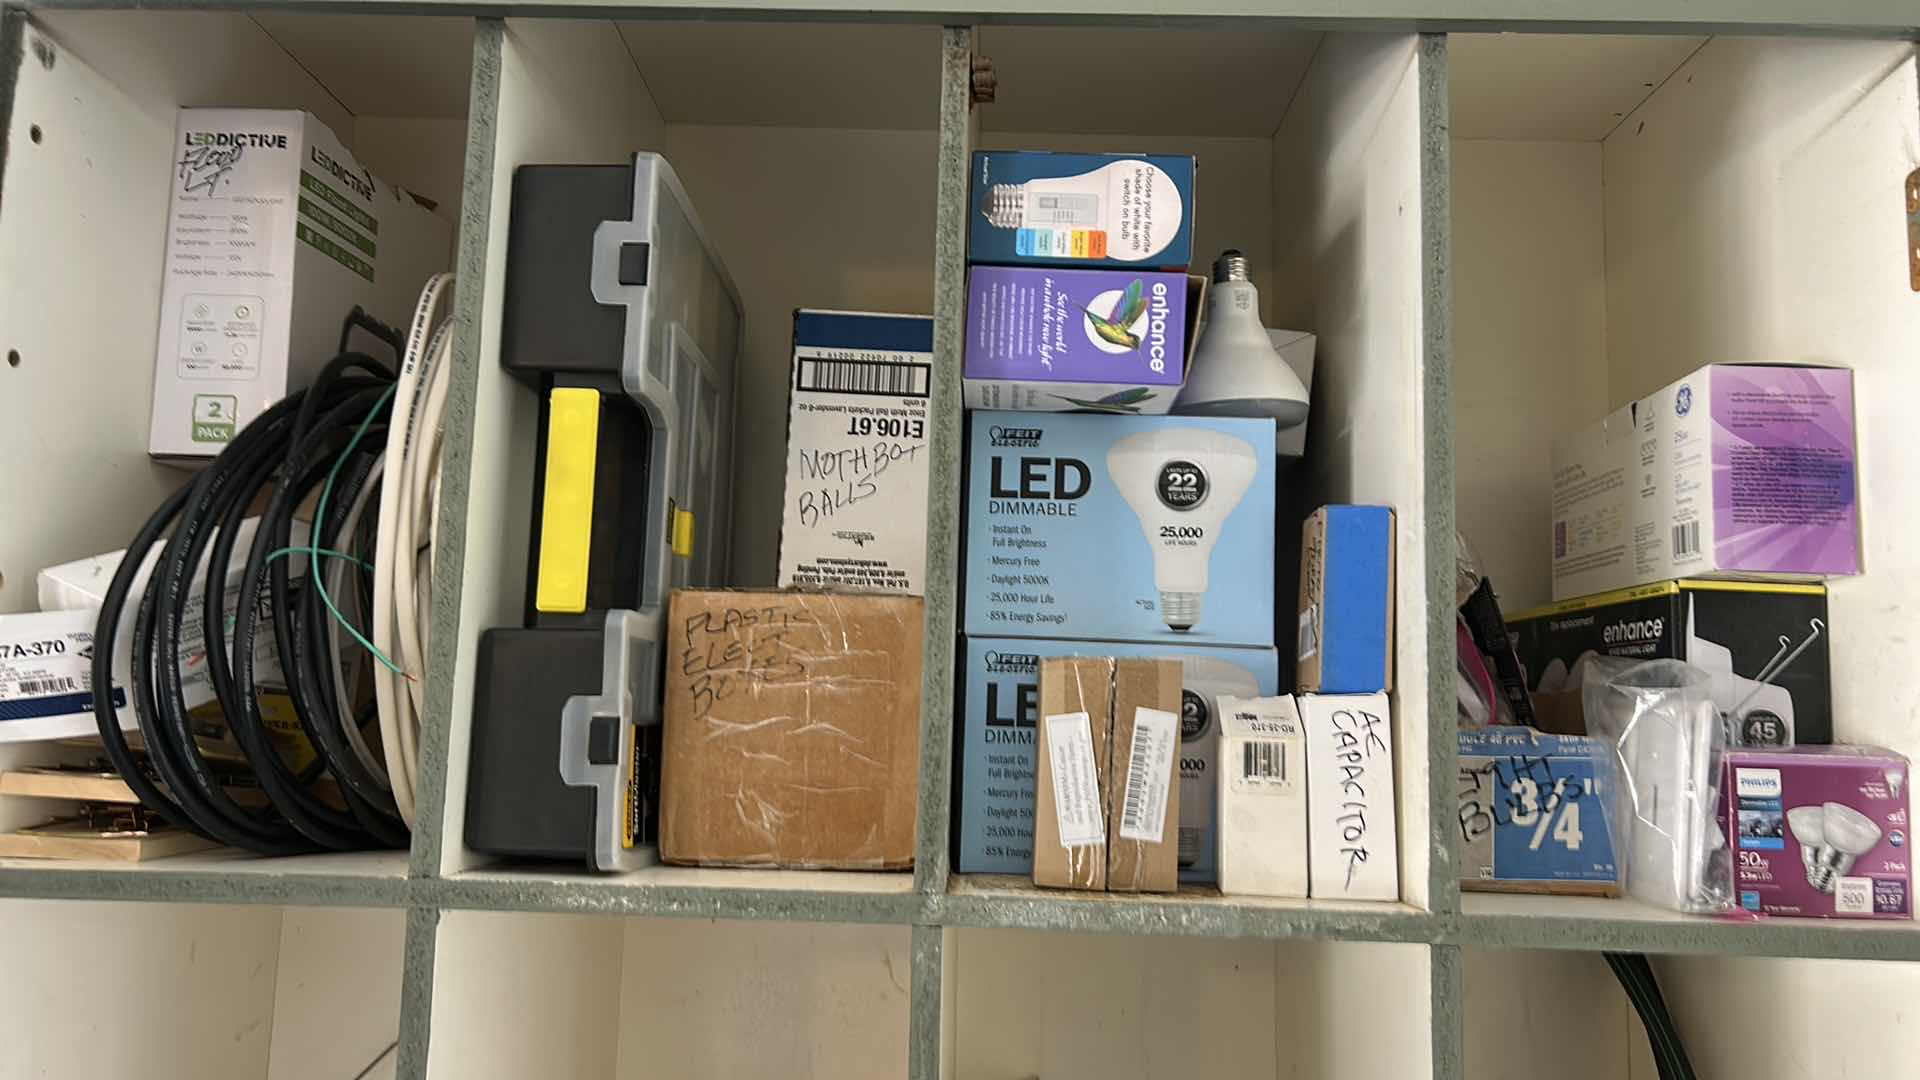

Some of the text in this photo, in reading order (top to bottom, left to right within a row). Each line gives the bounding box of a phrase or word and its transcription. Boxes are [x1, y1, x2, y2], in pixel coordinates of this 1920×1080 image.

[185, 132, 288, 149] LEDDICTIVE
[312, 146, 375, 202] LEDDICTIVE
[1122, 179, 1130, 205] switch
[1144, 166, 1154, 253] Choose your favorite
[1121, 221, 1130, 240] bulb
[1150, 282, 1169, 372] enhance
[208, 401, 222, 418] 2
[848, 406, 875, 416] Packets
[889, 408, 906, 417] Moth
[198, 426, 229, 440] PACK
[847, 416, 924, 439] E106.6T
[1004, 429, 1040, 438] FEIT
[991, 456, 1092, 500] LED
[1167, 472, 1198, 487] 22
[799, 473, 877, 528] BALLS
[989, 501, 1077, 516] DIMMABLE
[993, 525, 1032, 535] Instant On
[1160, 526, 1203, 539] 25,000
[992, 537, 1047, 549] Full Brightness
[992, 556, 1041, 568] Mercury Free
[991, 574, 1020, 586] Daylight
[990, 592, 1055, 604] 25,000 Hour Life
[1009, 611, 1034, 624] Energy
[686, 606, 809, 649] PLASTIC
[1603, 616, 1663, 643] enhance
[986, 682, 1037, 727] LE
[1182, 702, 1199, 716] 2
[985, 729, 1034, 744] DIMM
[1750, 721, 1777, 740] 45
[1505, 735, 1526, 745] PVC
[988, 754, 1029, 765] Instant On
[988, 768, 999, 779] Full
[1740, 777, 1778, 787] PHILIPS
[987, 788, 1018, 802] Mercury
[1331, 709, 1370, 892] CAPACITOR
[986, 807, 1015, 820] Daylight
[986, 827, 1014, 839] 25,000
